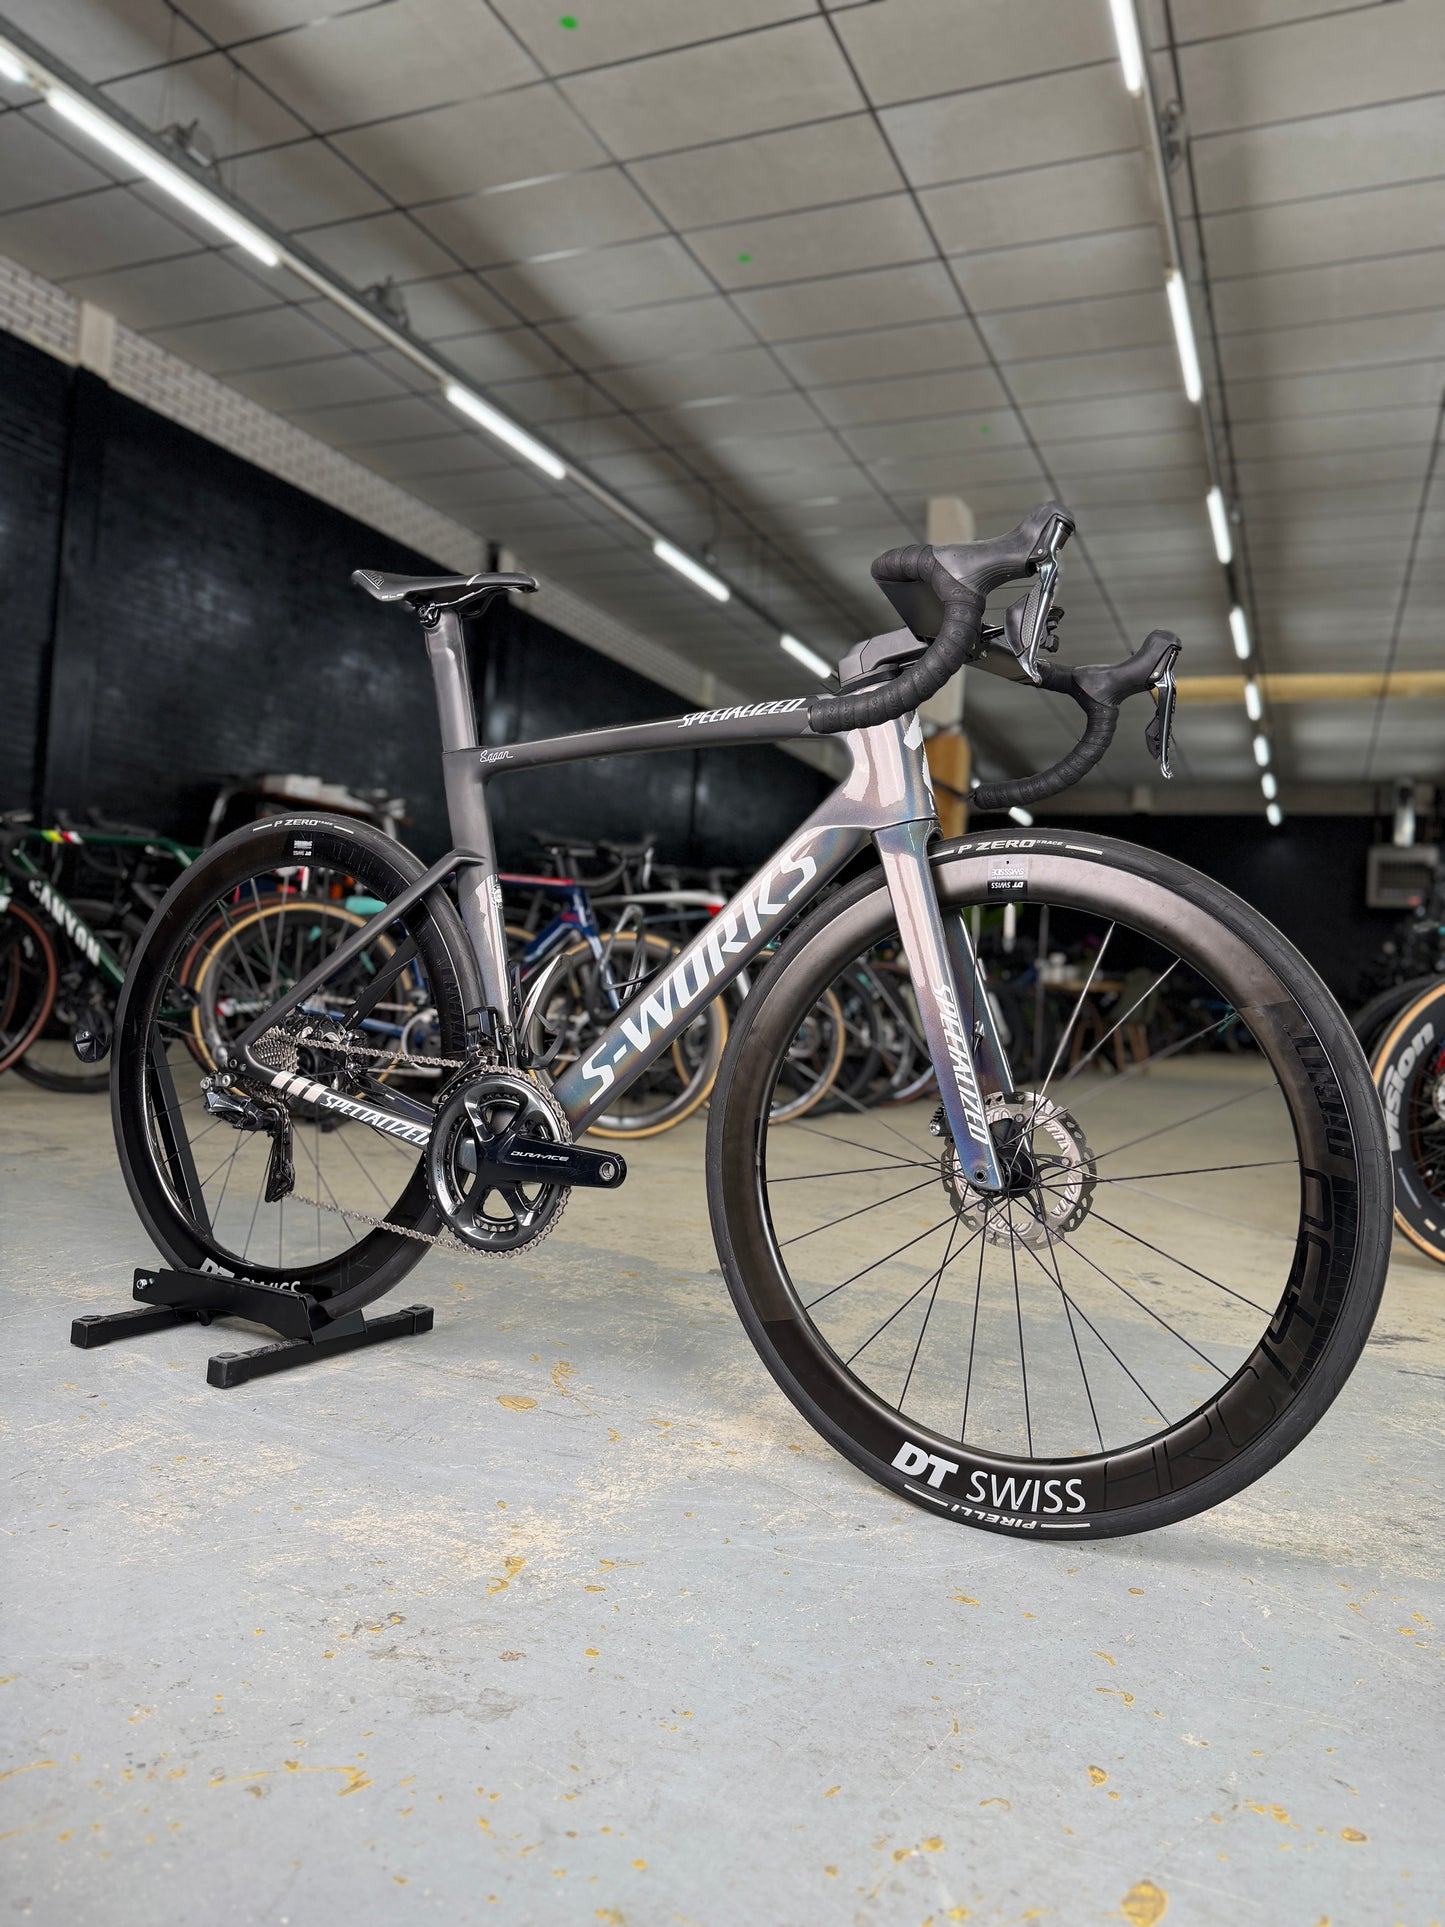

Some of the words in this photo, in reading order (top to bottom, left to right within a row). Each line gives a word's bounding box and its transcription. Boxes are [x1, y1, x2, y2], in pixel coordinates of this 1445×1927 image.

[678, 698, 807, 728] SPECIALIZED
[479, 749, 514, 763] Sagan
[274, 820, 282, 828] P
[957, 844, 973, 854] P
[976, 839, 1037, 851] ZERO
[1012, 881, 1024, 889] DT
[28, 879, 101, 967] CANYON
[582, 836, 818, 1104] S-WORKS
[930, 978, 989, 1145] SPECIALIZED
[319, 1091, 432, 1146] SPECIALIZED
[510, 1150, 569, 1162] DURA-ACE
[891, 1441, 959, 1489] DT
[965, 1470, 1086, 1514] SWISS
[950, 1503, 1038, 1530] PIRELLI
